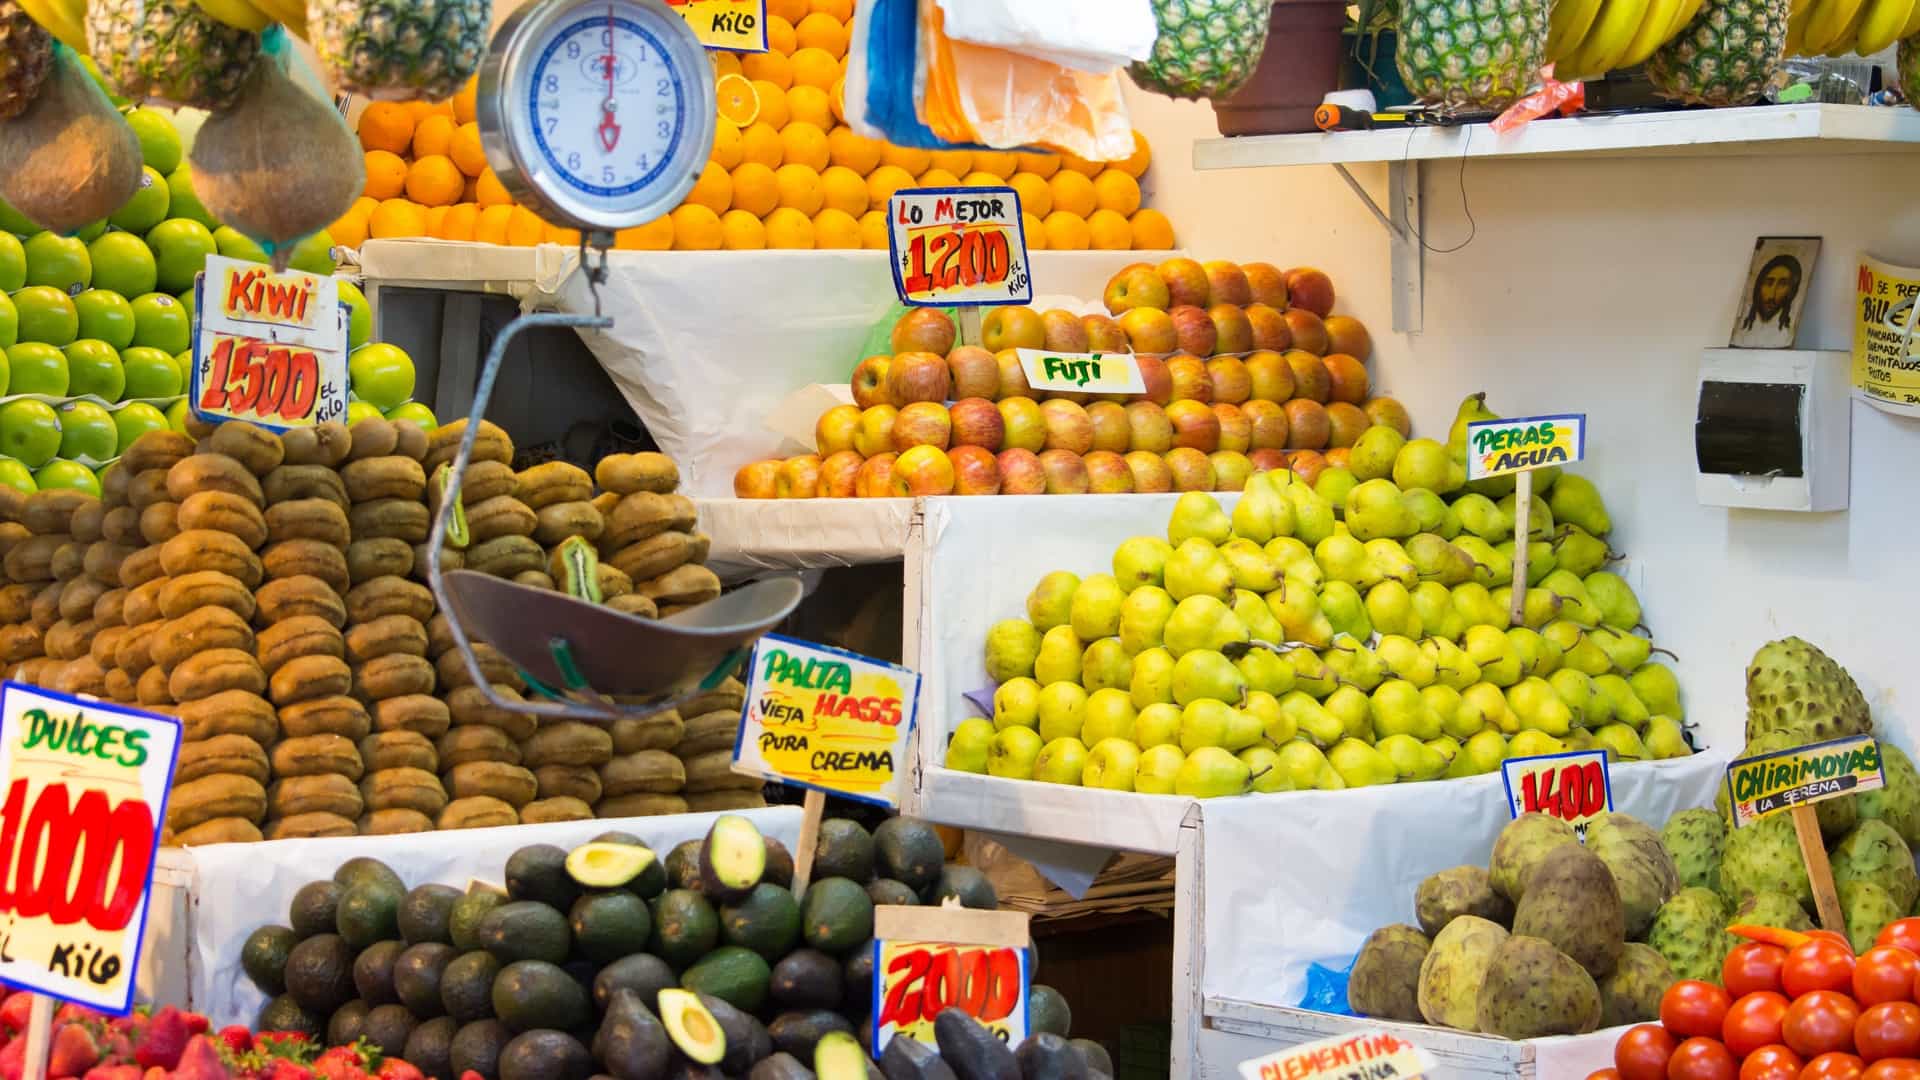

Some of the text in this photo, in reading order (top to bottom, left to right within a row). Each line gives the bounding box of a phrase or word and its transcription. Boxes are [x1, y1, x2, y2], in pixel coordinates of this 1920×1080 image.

[567, 41, 580, 59] 9
[639, 45, 647, 62] 1
[545, 75, 559, 93] 8
[657, 80, 670, 97] 2
[546, 118, 558, 135] 7
[658, 121, 671, 138] 3
[567, 152, 581, 170] 6
[636, 154, 648, 171] 4
[602, 166, 615, 184] 5
[935, 197, 1005, 223] MEJOR
[1857, 264, 1920, 298] NO SE RE
[320, 381, 338, 398] EL
[1473, 422, 1555, 454] PERAS
[1493, 446, 1567, 471] AGUA
[762, 649, 852, 694] PALTA
[813, 693, 903, 727] HASS
[759, 731, 894, 772] PURA CREMA
[1761, 800, 1774, 811] LA
[1784, 780, 1841, 803] SERENA
